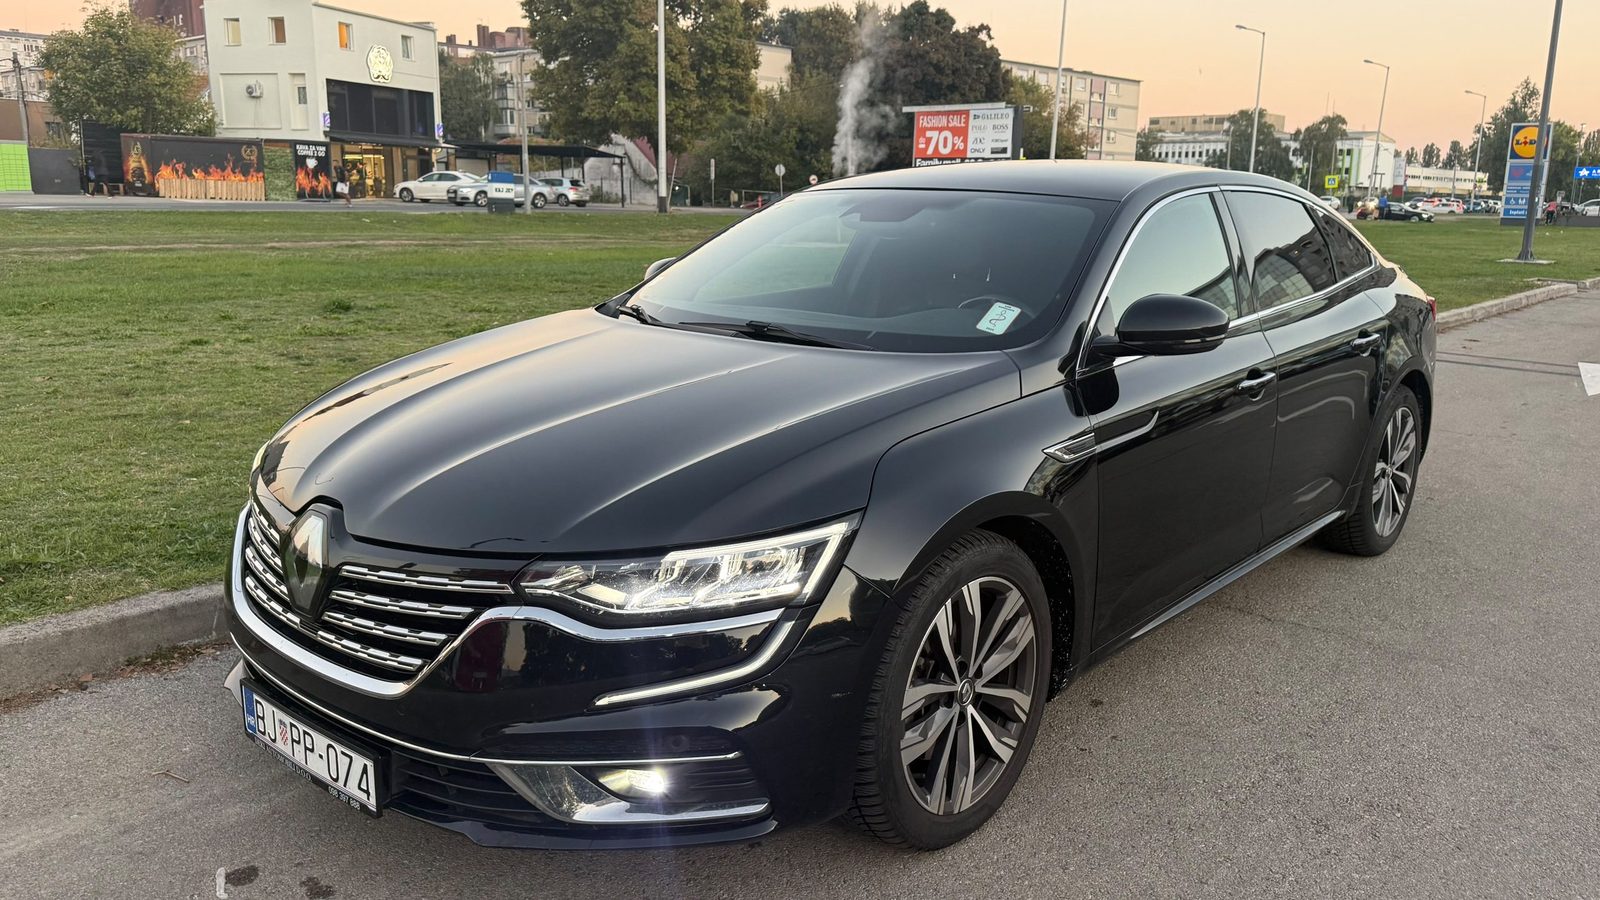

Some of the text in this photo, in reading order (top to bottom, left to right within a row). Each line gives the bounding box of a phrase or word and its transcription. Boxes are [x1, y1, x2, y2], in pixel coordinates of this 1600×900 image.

[919, 115, 966, 128] FASHION SALE
[254, 698, 371, 802] BJ PP-074
